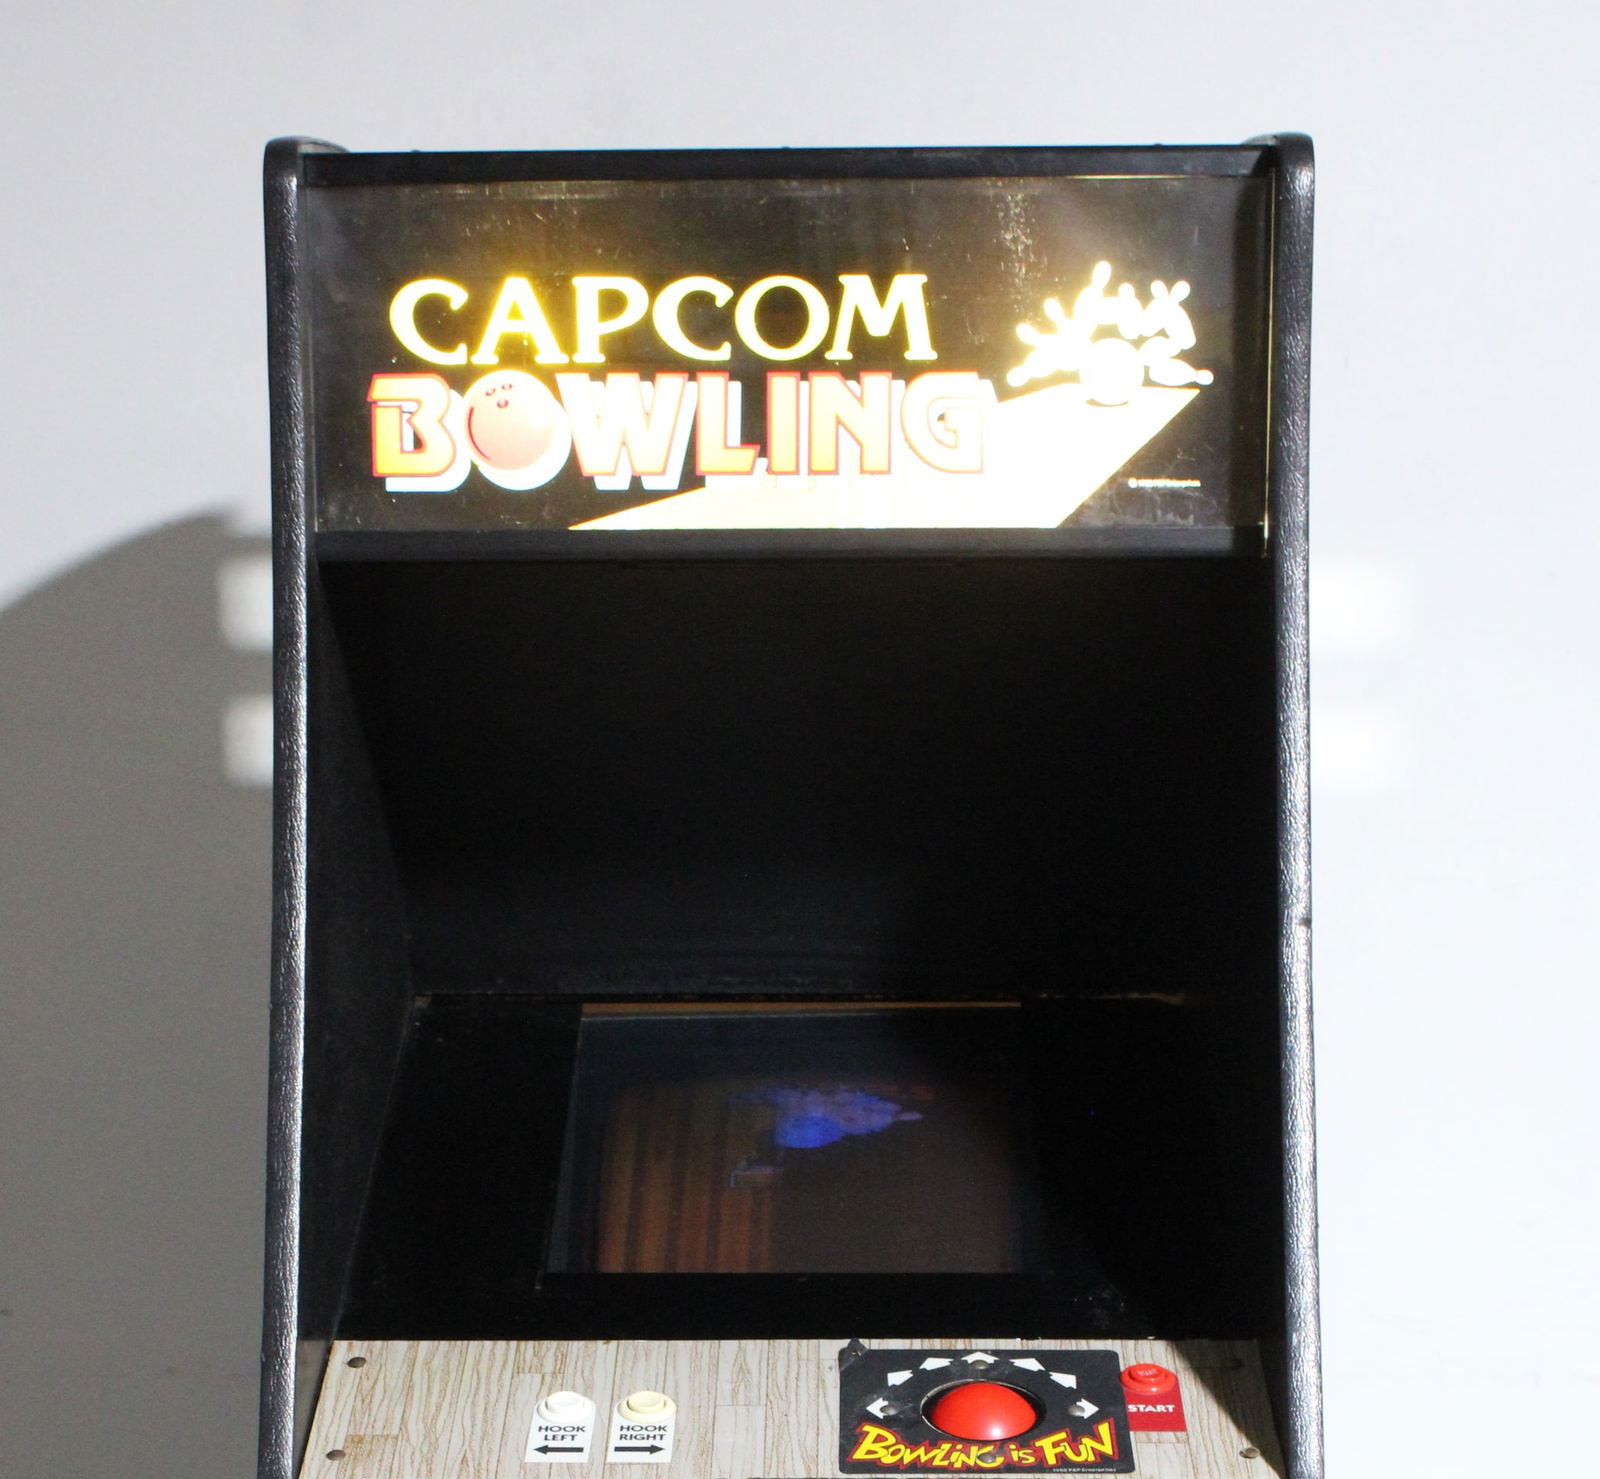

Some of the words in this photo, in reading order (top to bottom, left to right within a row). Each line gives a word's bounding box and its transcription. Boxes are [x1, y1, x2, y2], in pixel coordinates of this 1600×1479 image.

[389, 273, 938, 365] CAPCOM
[367, 369, 988, 490] BOWLING
[537, 1425, 587, 1433] HOOK
[1127, 1404, 1176, 1413] START
